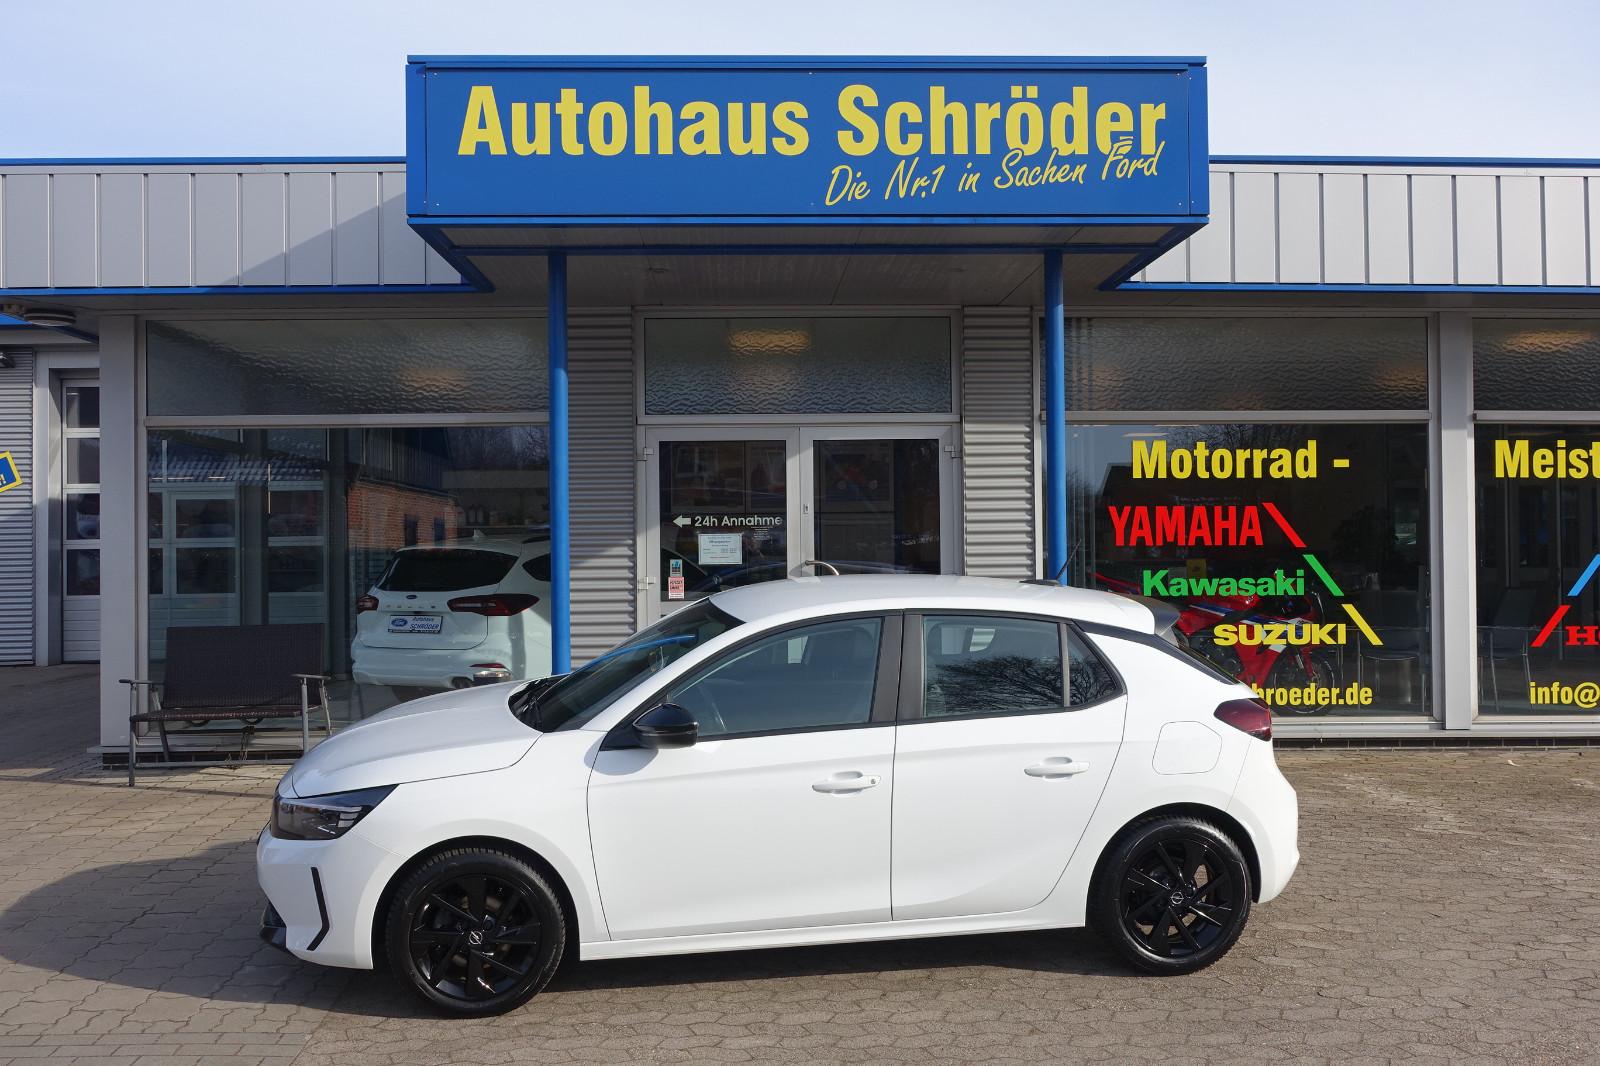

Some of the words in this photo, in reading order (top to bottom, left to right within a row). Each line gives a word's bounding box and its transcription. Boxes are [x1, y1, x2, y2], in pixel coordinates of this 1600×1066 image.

[458, 85, 809, 156] Autohaus
[837, 84, 1166, 156] Schröder
[825, 164, 870, 206] Die
[958, 162, 981, 193] in
[994, 149, 1087, 189] Sachen
[1101, 140, 1166, 181] Ford
[1132, 439, 1317, 479] Motorrad
[1494, 439, 1600, 479] Meist
[694, 515, 718, 527] 24h
[721, 514, 783, 527] Annahme
[1108, 505, 1264, 546] YAMAHA
[1143, 569, 1305, 597] Kawasaki
[1213, 623, 1347, 646] SUZUKI
